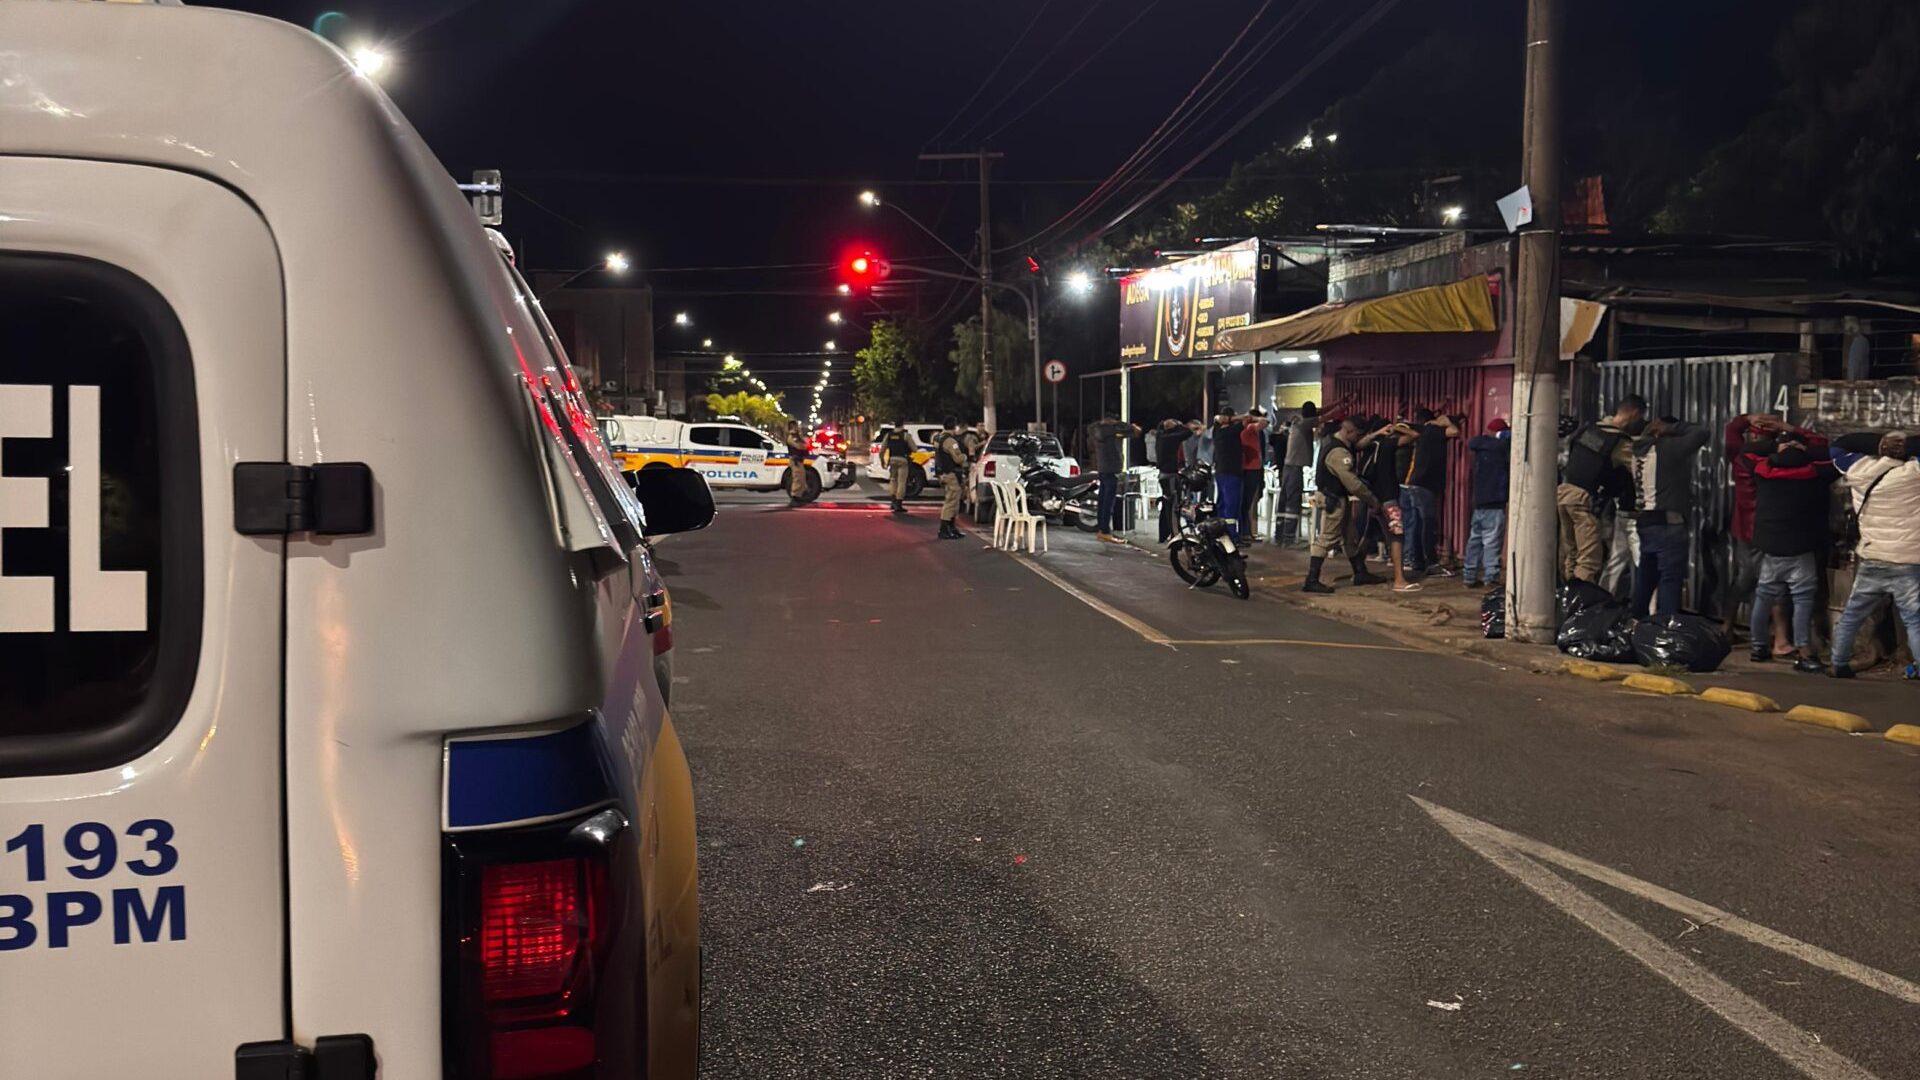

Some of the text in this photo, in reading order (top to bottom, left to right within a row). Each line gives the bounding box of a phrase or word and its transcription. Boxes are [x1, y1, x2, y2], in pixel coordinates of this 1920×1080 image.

[0, 384, 148, 632] EL
[6, 818, 179, 882] 193
[0, 885, 187, 951] BPM
